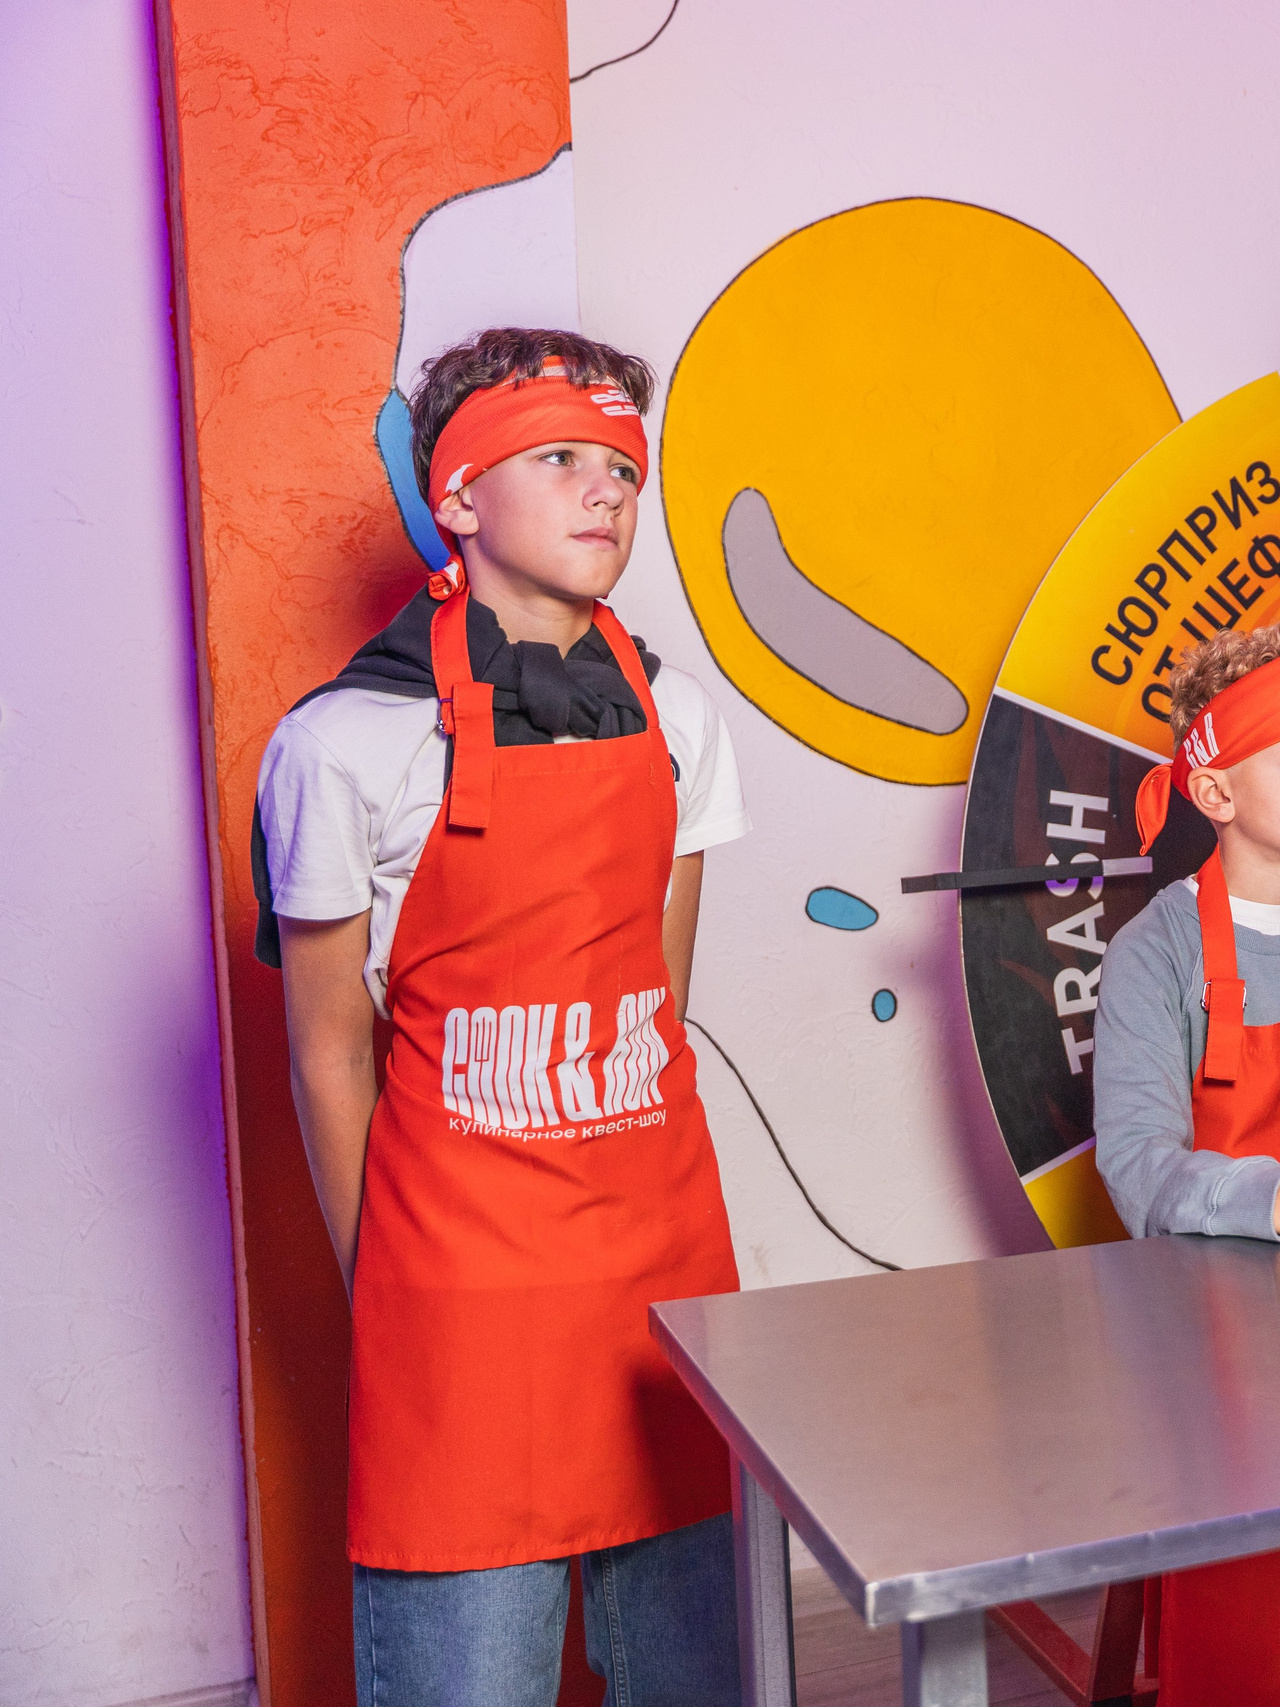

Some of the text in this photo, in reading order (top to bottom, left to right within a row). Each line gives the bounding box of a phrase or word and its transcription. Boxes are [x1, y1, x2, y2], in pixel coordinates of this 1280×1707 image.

[1046, 790, 1108, 1075] TRASH
[442, 1003, 560, 1129] COOK
[557, 1002, 603, 1121] &
[582, 1109, 667, 1138] квест-шоу
